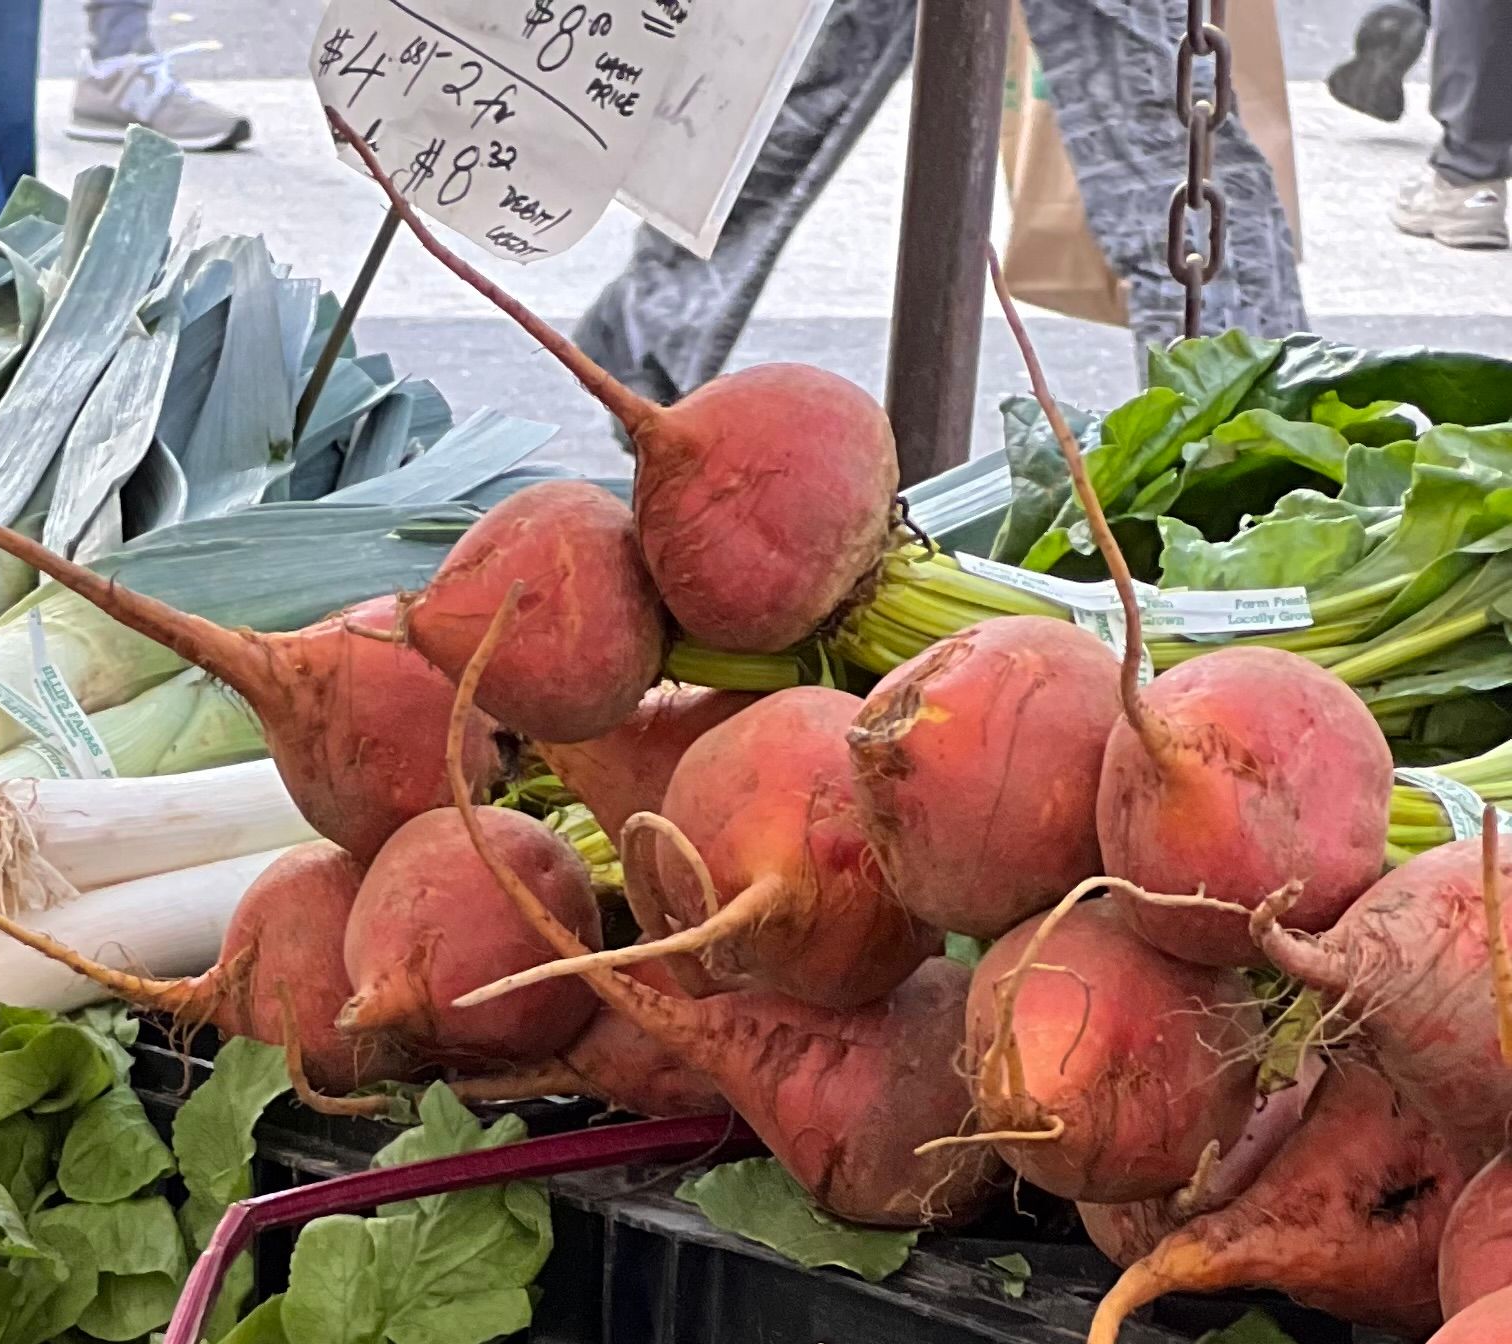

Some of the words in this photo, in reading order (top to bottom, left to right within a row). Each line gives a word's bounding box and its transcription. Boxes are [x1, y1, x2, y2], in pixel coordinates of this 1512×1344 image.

[586, 78, 641, 117] PRICE
[1235, 599, 1270, 610] Farm
[1228, 612, 1275, 625] Locally
